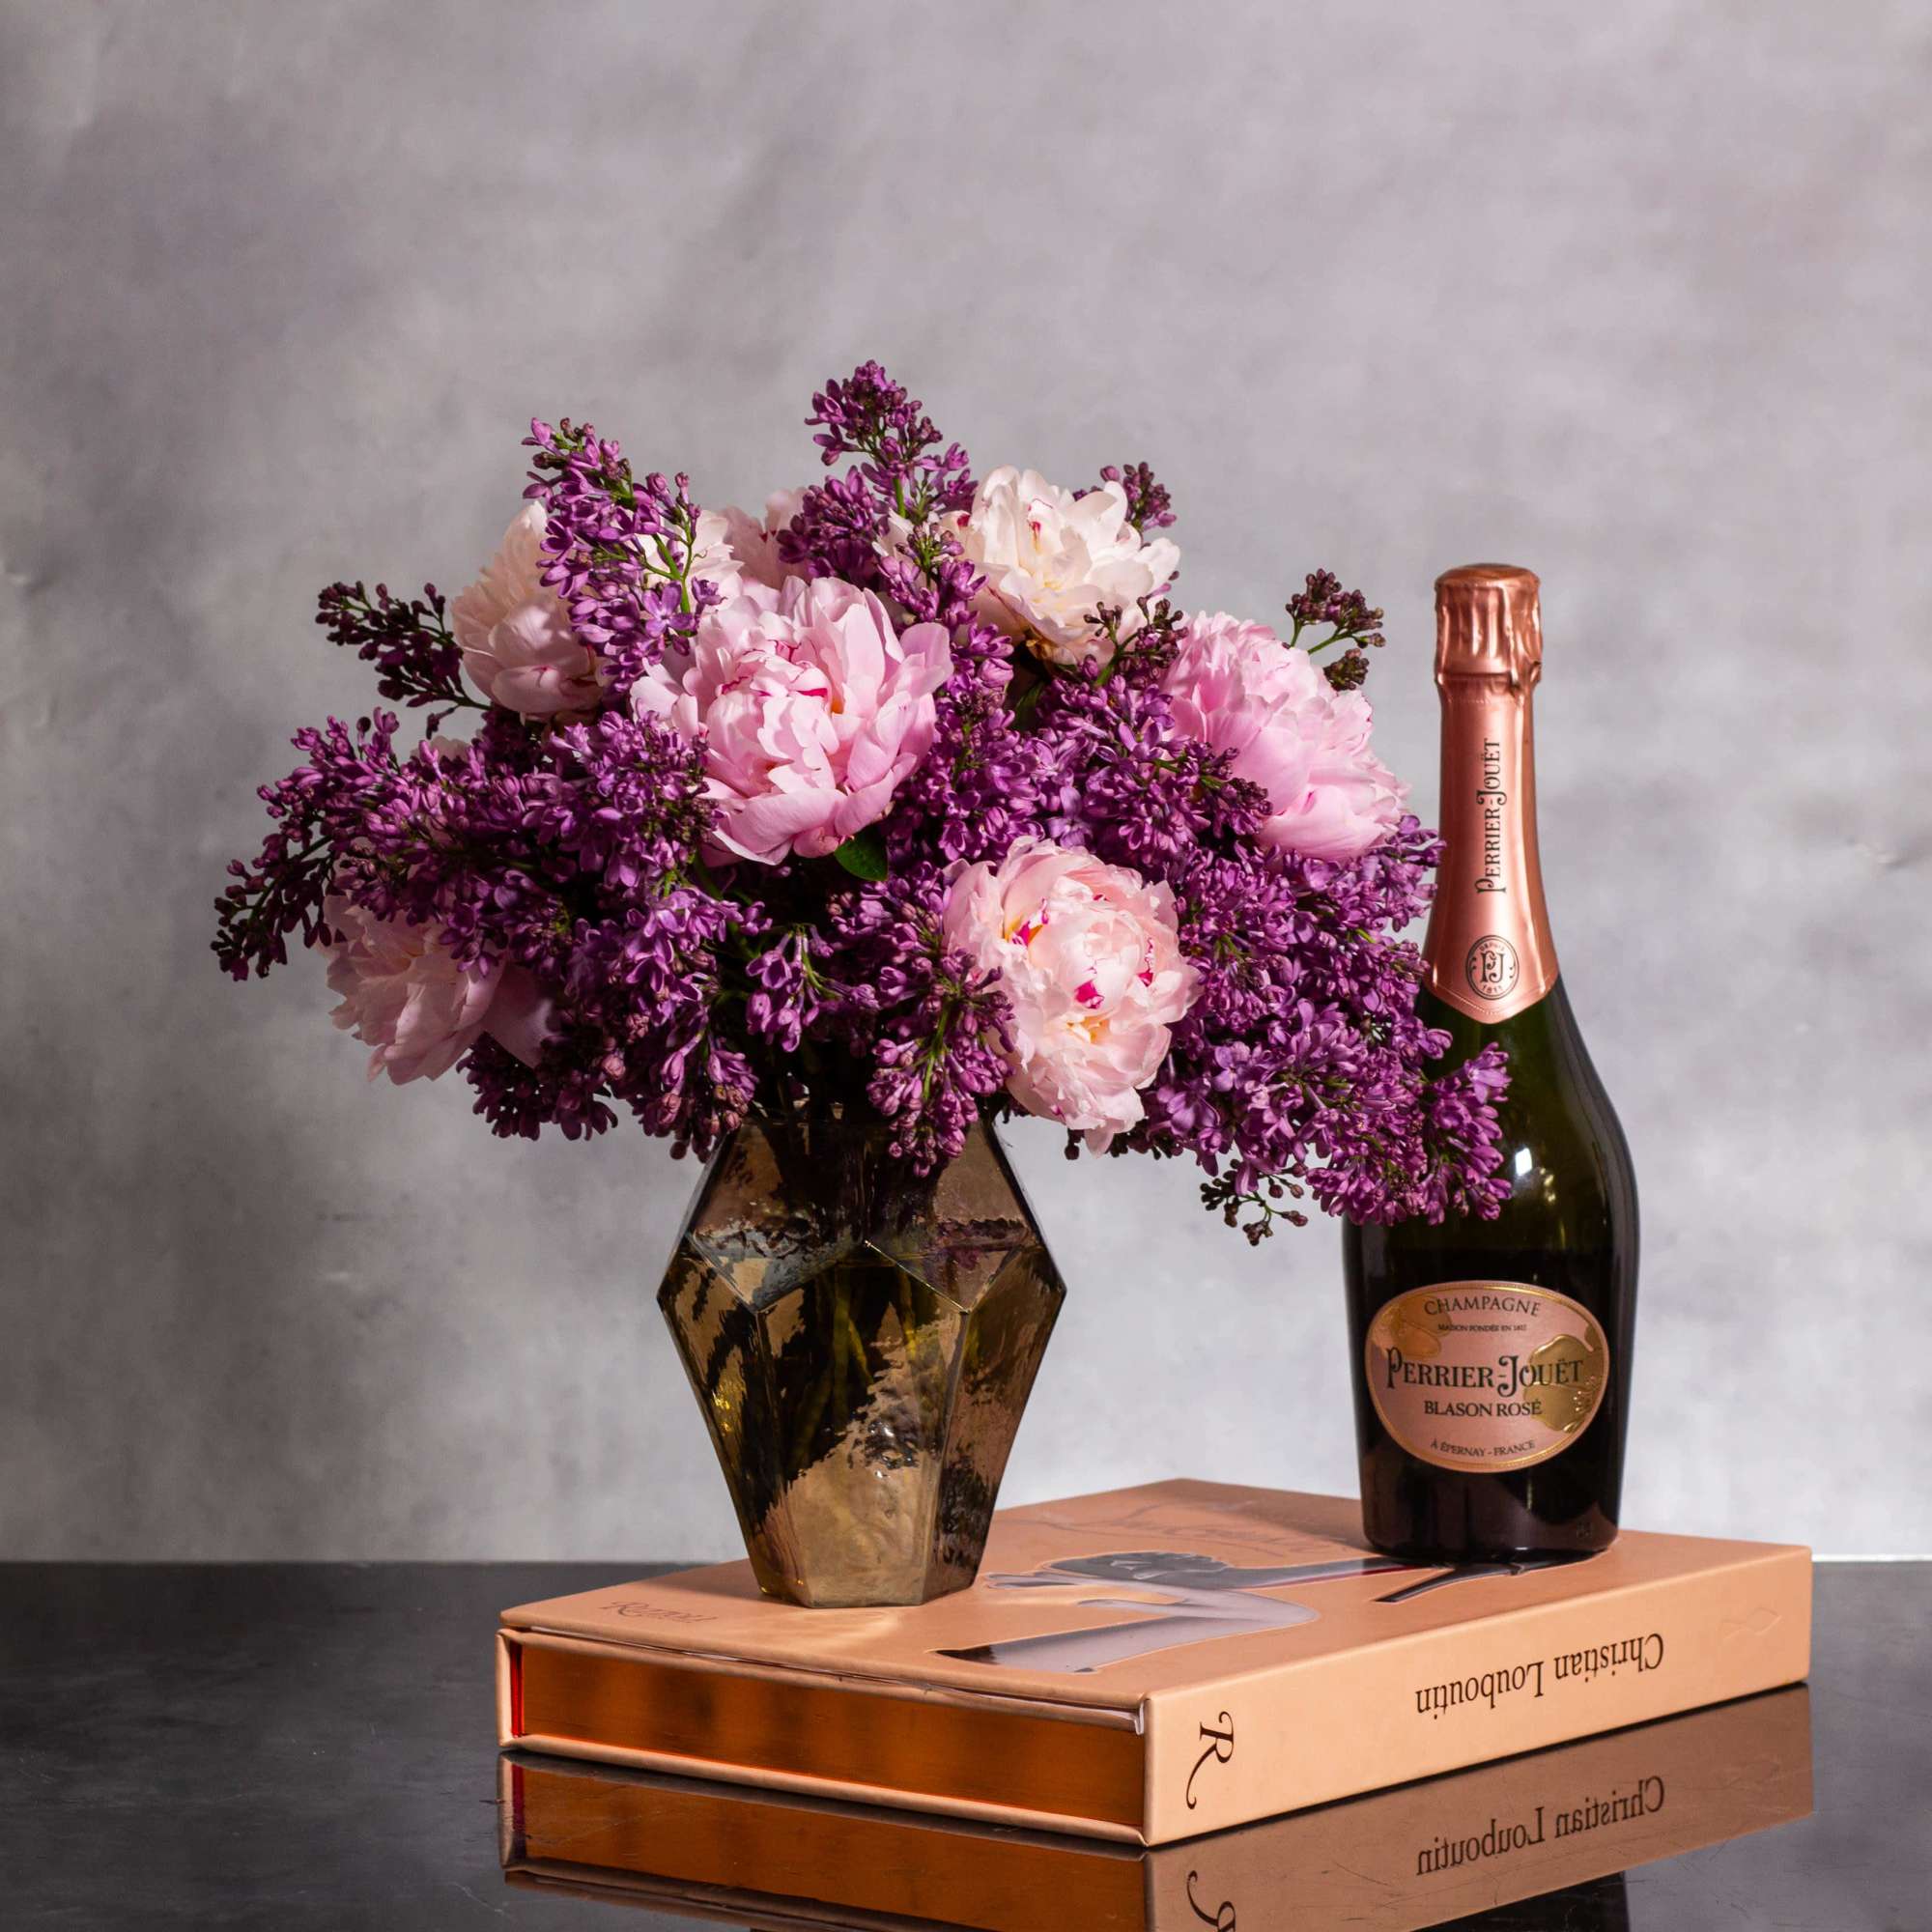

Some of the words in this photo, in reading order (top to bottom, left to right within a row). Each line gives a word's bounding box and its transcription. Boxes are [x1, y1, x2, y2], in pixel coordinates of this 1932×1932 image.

[1474, 738, 1507, 894] PERRIER-JOUËT
[1424, 1295, 1541, 1317] CHAMPAGNE
[1386, 1347, 1584, 1398] PERRIER-JOUËT
[1424, 1401, 1492, 1417] BLASON
[1496, 1399, 1543, 1417] ROSÉ
[1440, 1440, 1485, 1458] ÉPERNAY
[1493, 1439, 1536, 1457] FRANCE
[1554, 1633, 1664, 1684] Christian
[1415, 1661, 1545, 1720] Louboutin
[1185, 1710, 1236, 1811] R
